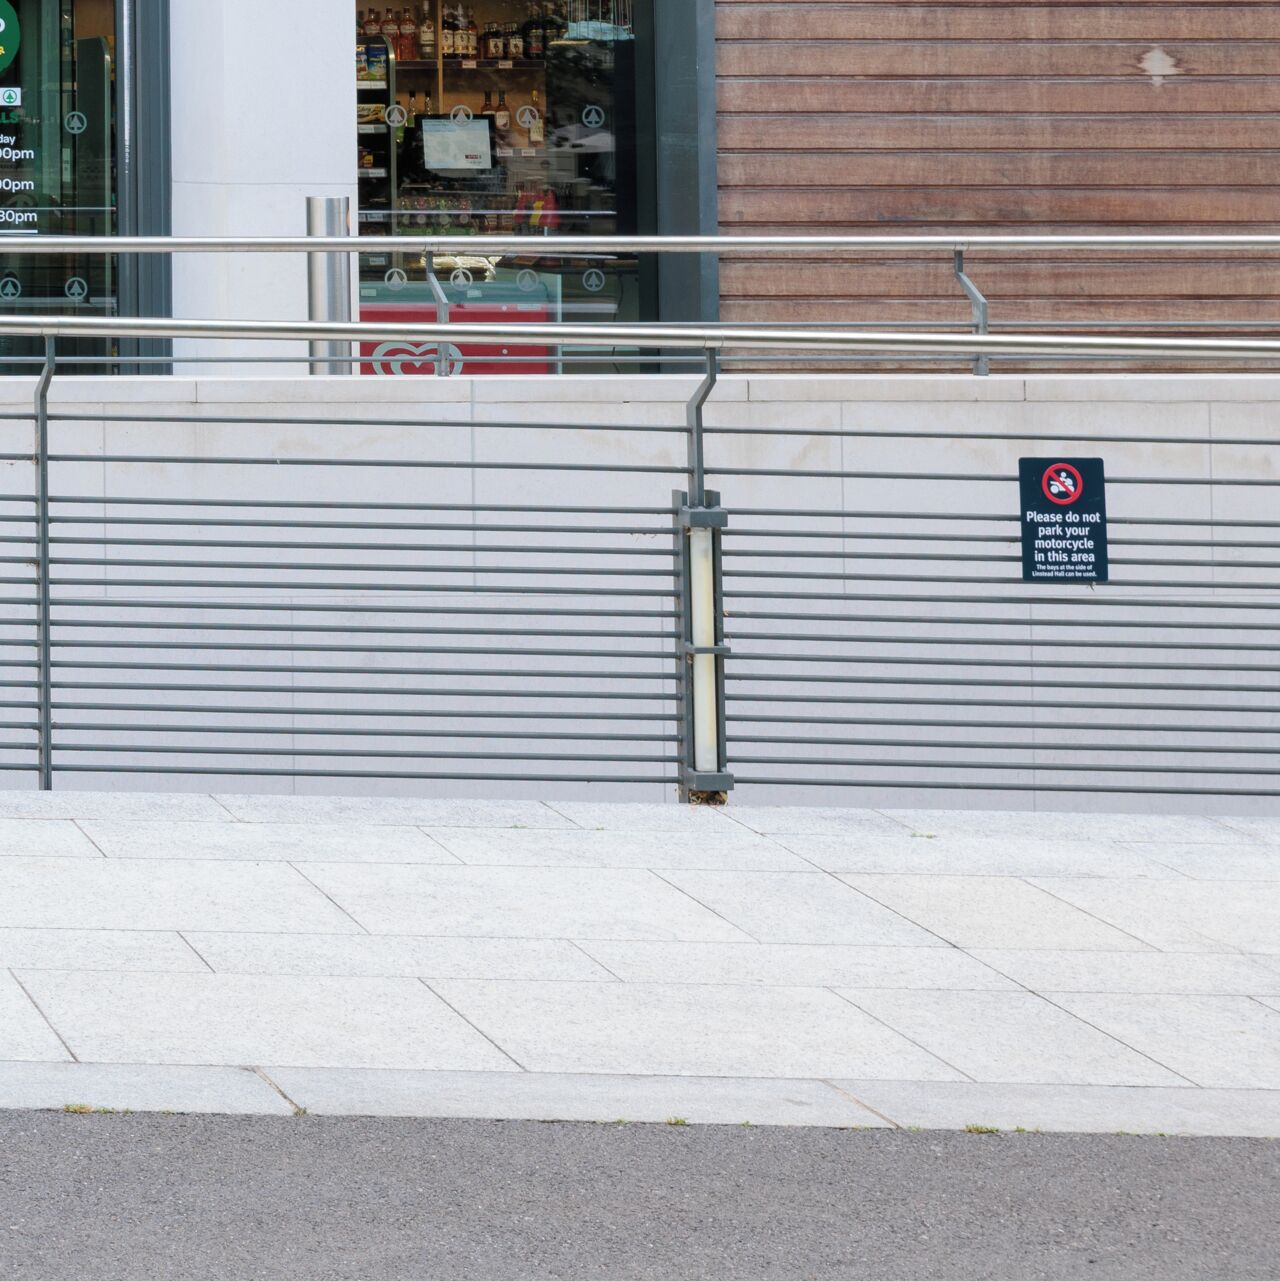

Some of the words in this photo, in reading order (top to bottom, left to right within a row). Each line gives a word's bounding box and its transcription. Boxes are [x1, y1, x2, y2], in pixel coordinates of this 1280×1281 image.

[1026, 511, 1062, 523] Please
[1065, 511, 1080, 523] do
[1082, 512, 1101, 523] not
[1038, 525, 1062, 537] park
[1065, 527, 1090, 538] your
[1035, 538, 1094, 551] motorcycle
[1034, 551, 1045, 562] in
[1047, 551, 1068, 562] this
[1071, 553, 1095, 562] area
